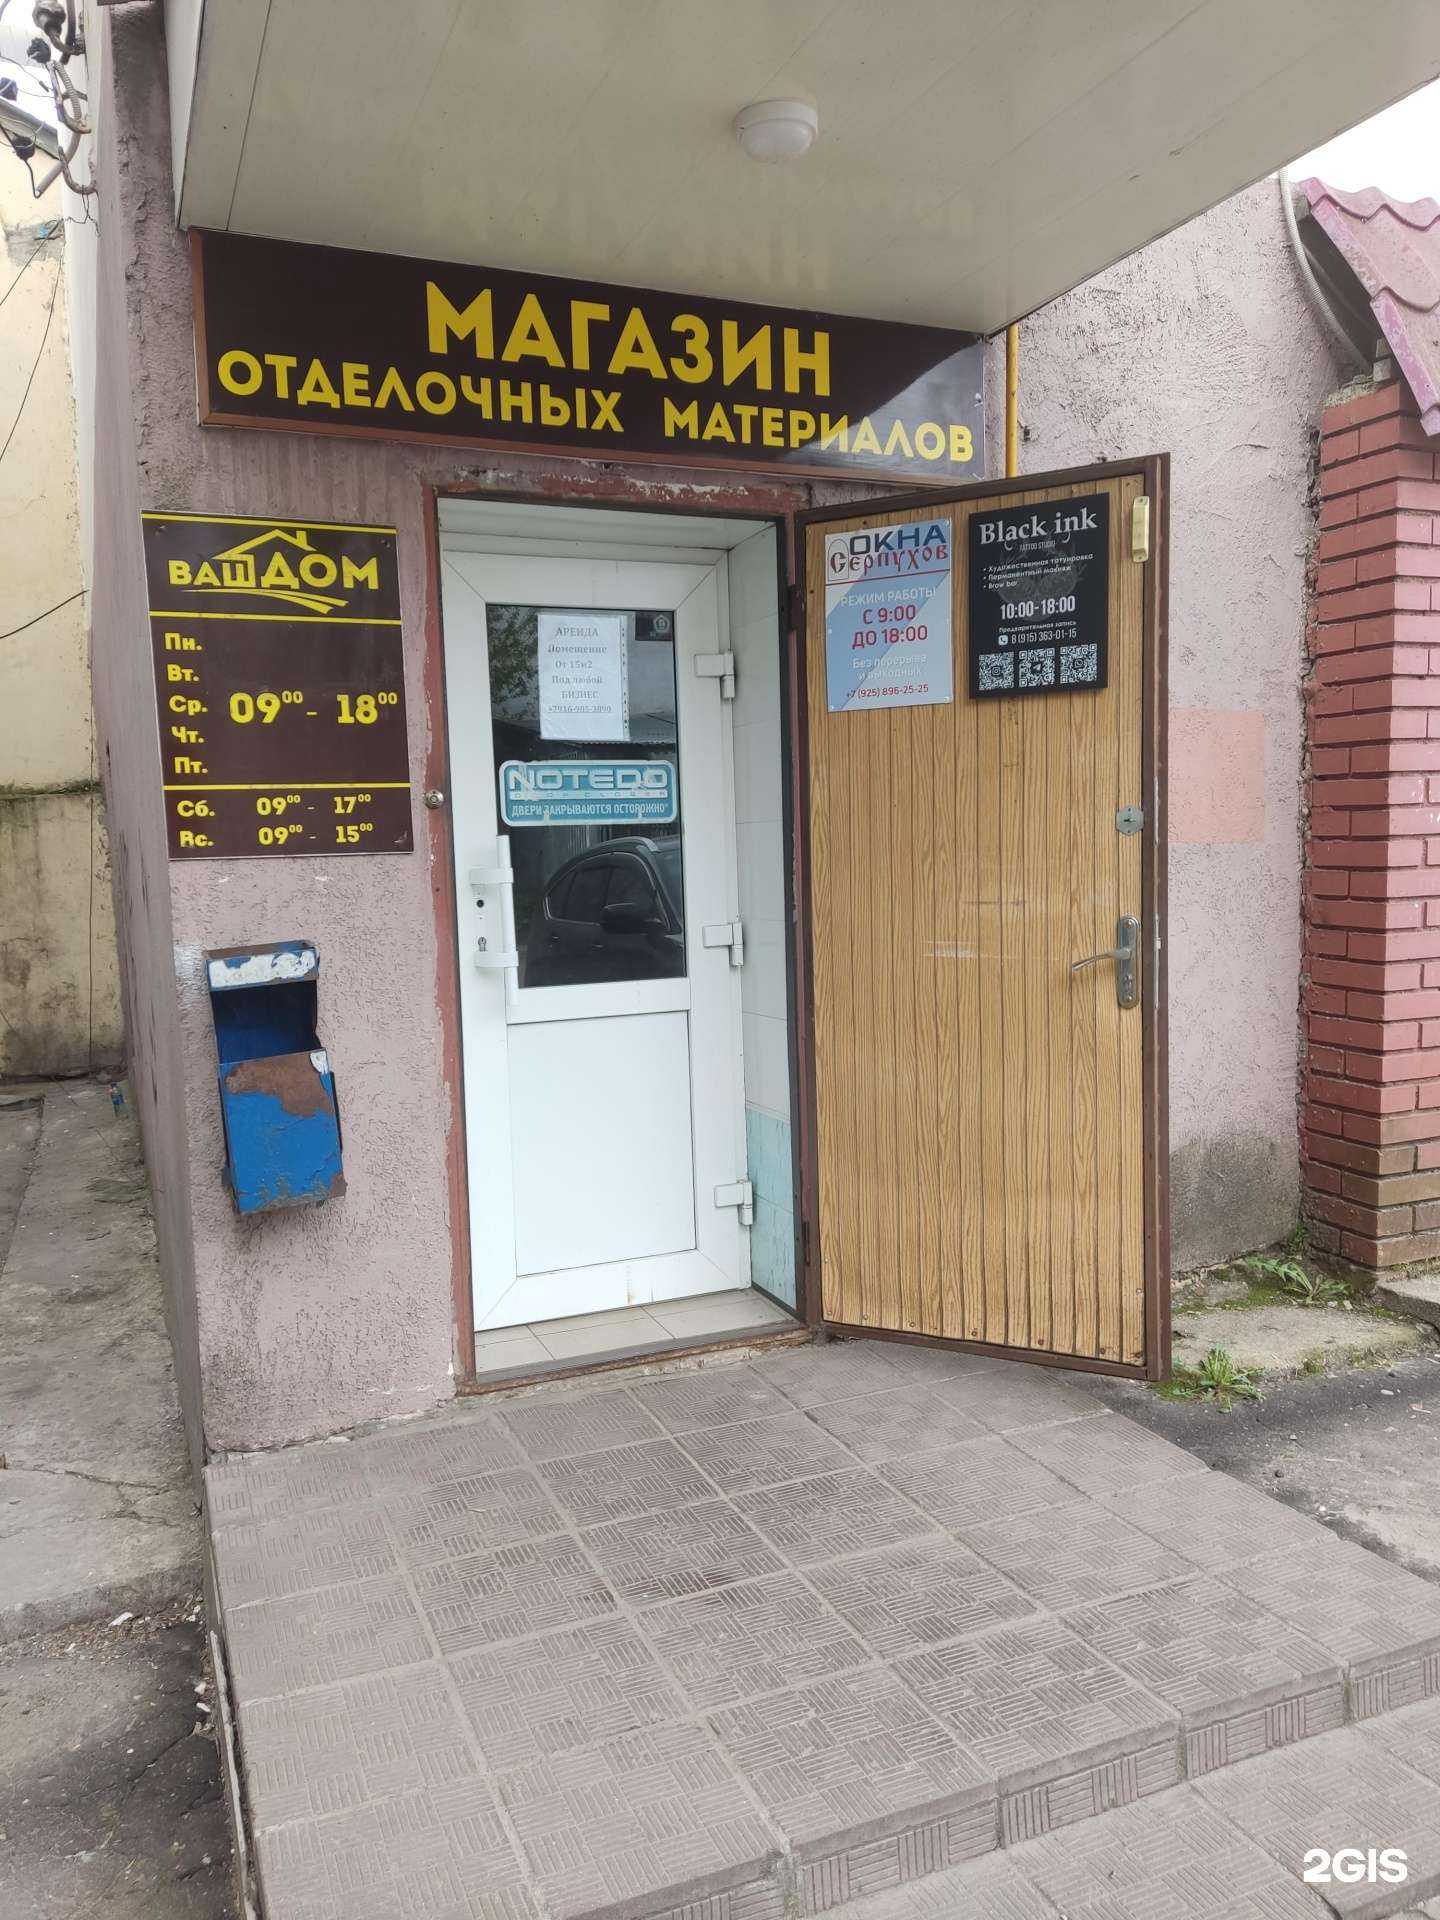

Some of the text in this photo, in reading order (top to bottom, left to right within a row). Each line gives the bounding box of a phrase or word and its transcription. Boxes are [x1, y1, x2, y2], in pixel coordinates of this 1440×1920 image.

[425, 280, 830, 397] МАГАЗИН
[217, 349, 975, 464] ОТДЕЛОЧНЫХ МАТЕРИАЛОВ
[978, 507, 1098, 549] Black ink
[850, 524, 947, 556] ОКНА
[830, 544, 949, 576] Серпухов
[168, 552, 379, 590] ВАШ ДОМ
[840, 586, 936, 606] РЕЖИМ РАБОТЫ
[878, 604, 917, 623] 9:00
[164, 633, 202, 650] Пн.
[555, 627, 599, 638] АРЕНДА
[852, 625, 928, 649] ДО 18:00
[555, 660, 567, 669] От
[852, 657, 871, 669] Без
[167, 664, 200, 682] Вт.
[858, 687, 881, 700] (925)
[882, 684, 929, 696] 896-25-25
[169, 695, 208, 715] Ср.
[171, 726, 204, 743] Чт.
[174, 757, 208, 774] Пт.
[509, 768, 668, 790] NOTEDO
[177, 800, 215, 817] Сб.
[511, 804, 542, 817] ДВЕРИ
[543, 803, 612, 816] ЗАКРЫВАЮТСЯ
